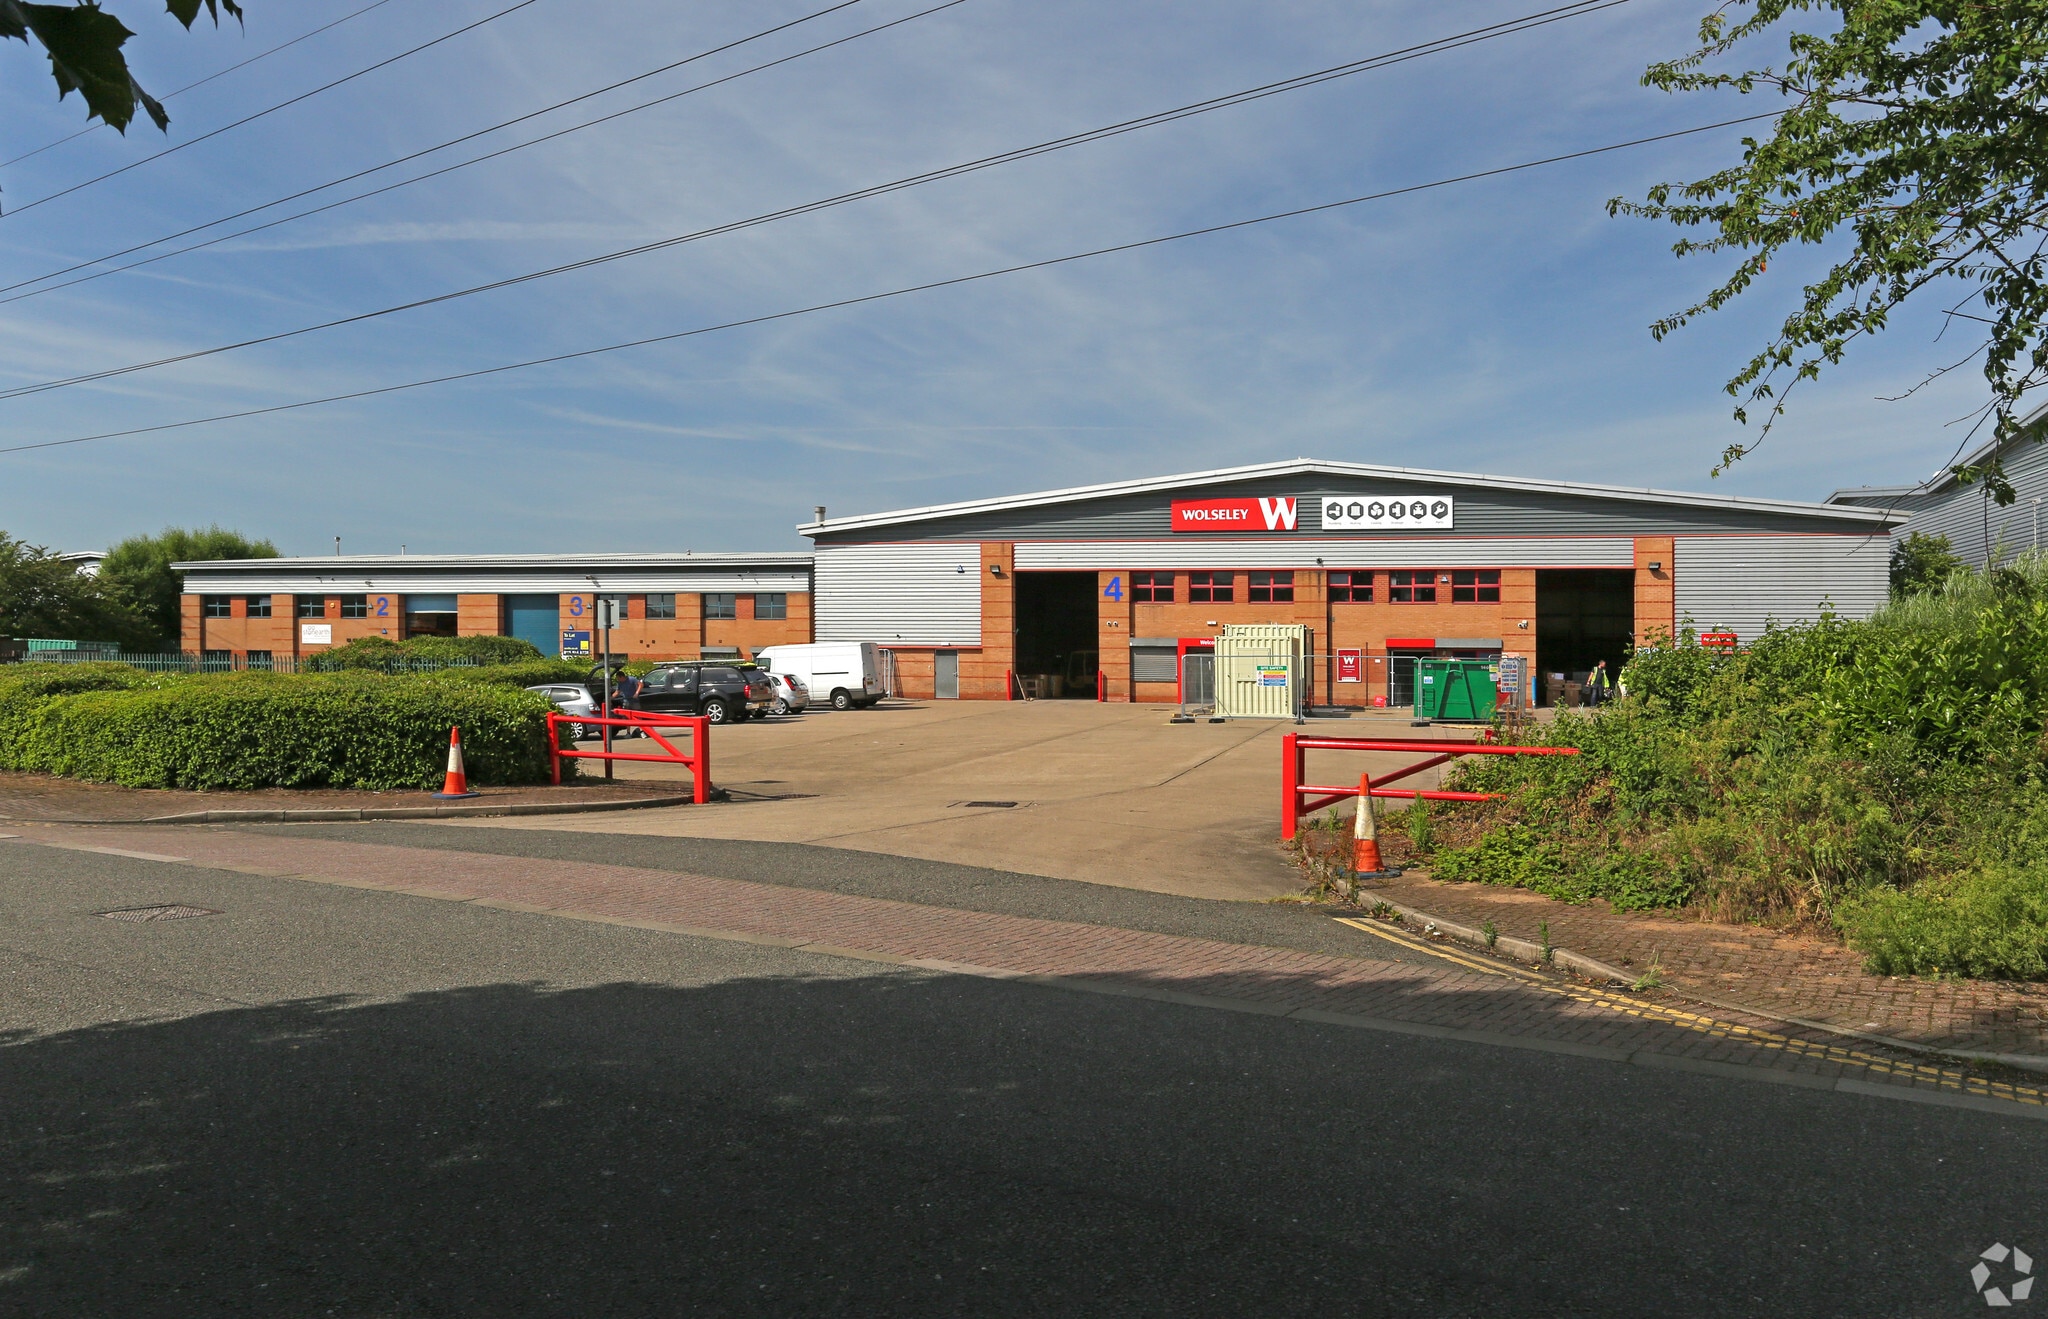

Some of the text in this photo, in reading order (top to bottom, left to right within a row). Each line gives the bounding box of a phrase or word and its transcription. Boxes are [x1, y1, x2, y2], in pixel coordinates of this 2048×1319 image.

[1182, 509, 1249, 520] WOLSELEY
[1258, 498, 1297, 530] W
[1104, 576, 1123, 602] 4
[377, 597, 389, 616] 2
[570, 596, 583, 616] 3
